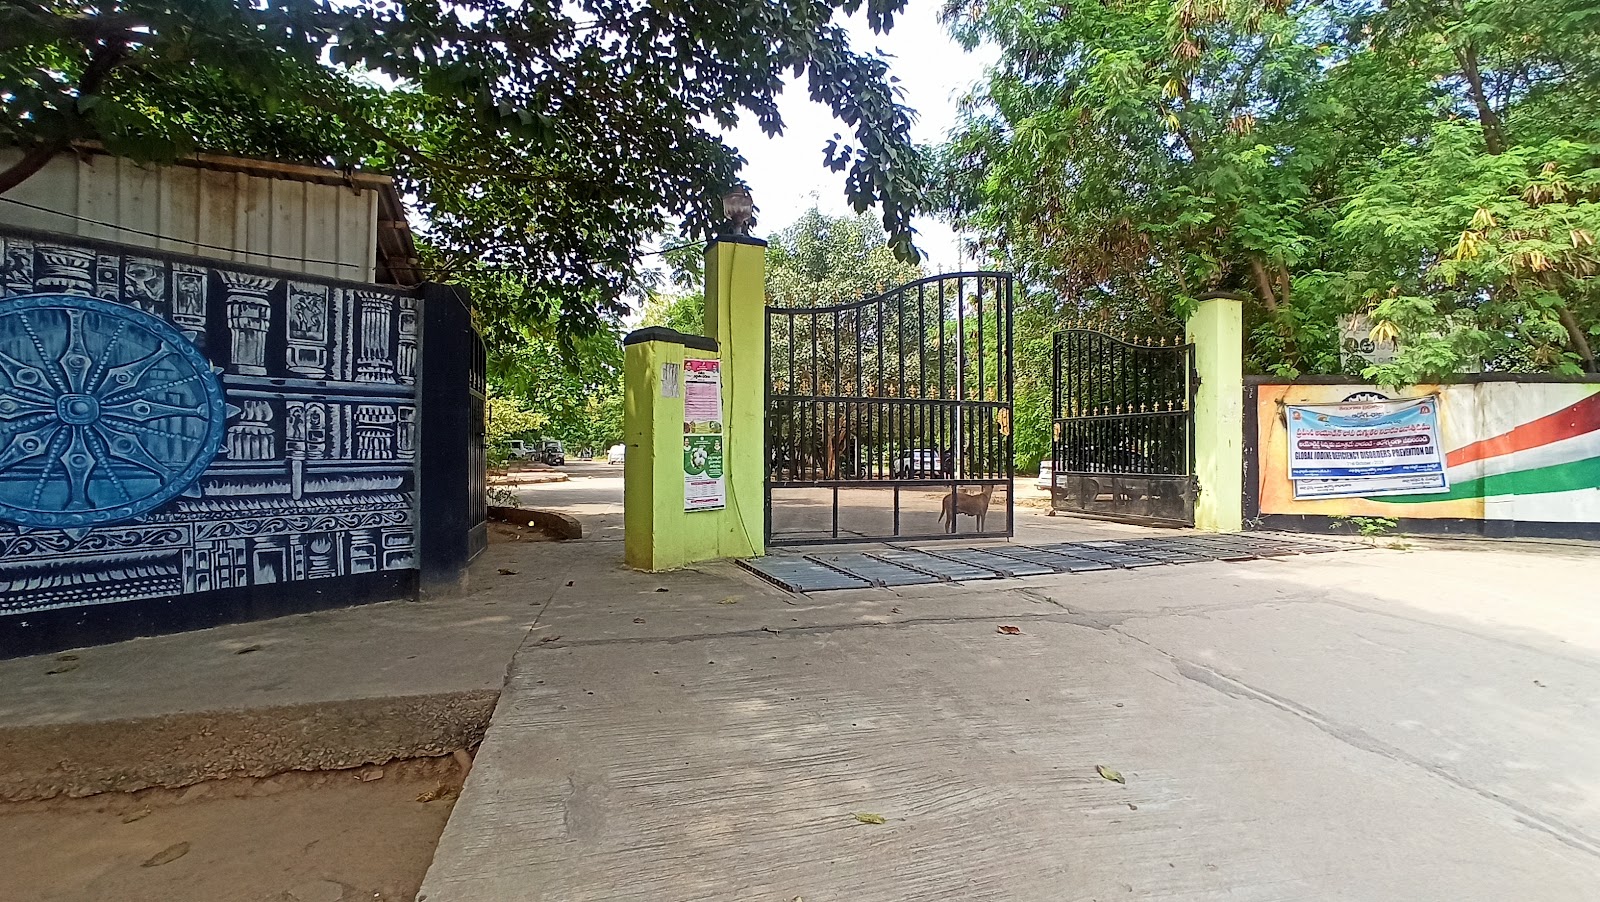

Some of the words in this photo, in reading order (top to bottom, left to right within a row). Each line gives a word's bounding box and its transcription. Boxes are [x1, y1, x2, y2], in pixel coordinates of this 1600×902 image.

[1332, 451, 1359, 460] DEFICIENCY
[1360, 450, 1391, 459] DISORDERS
[1392, 446, 1424, 457] PREVENTION
[1425, 446, 1434, 454] DAY
